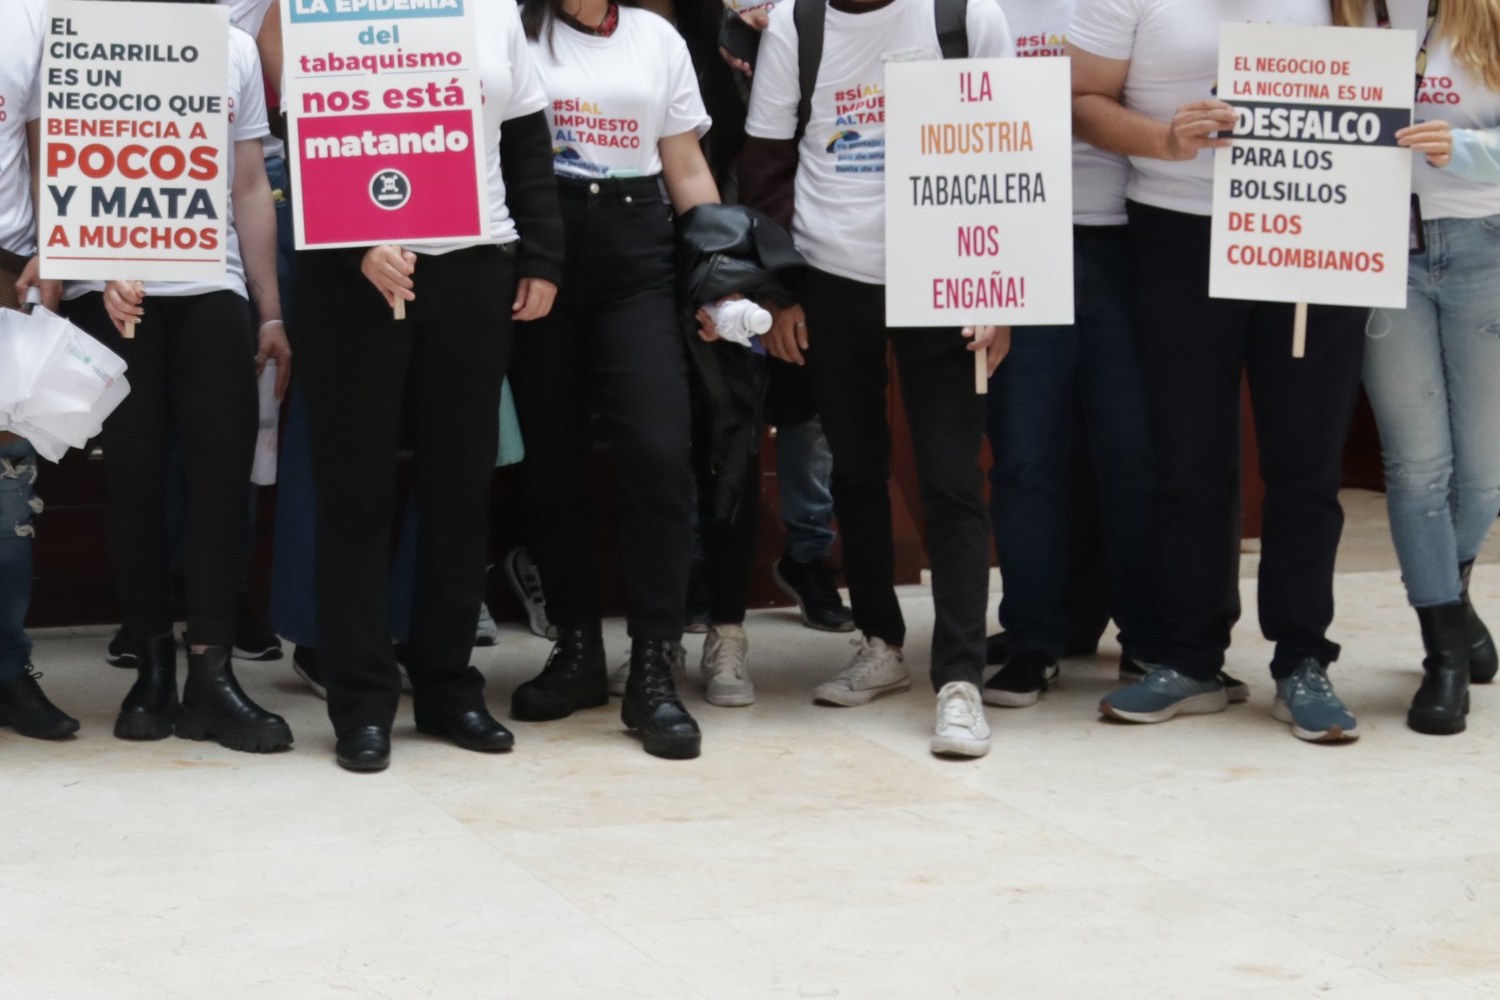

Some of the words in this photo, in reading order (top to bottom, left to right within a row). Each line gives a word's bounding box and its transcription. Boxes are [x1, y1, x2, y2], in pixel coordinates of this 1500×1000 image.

[51, 18, 78, 35] EL
[358, 25, 399, 45] del
[50, 42, 199, 63] CIGARRILLO
[300, 48, 462, 74] tabaquismo
[49, 68, 79, 86] ES
[87, 70, 122, 87] UN
[1234, 57, 1251, 71] EL
[1256, 58, 1326, 74] NEGOCIO
[1331, 61, 1350, 75] DE
[302, 88, 370, 113] nos
[383, 78, 464, 108] está
[1234, 81, 1252, 96] LA
[1257, 82, 1329, 99] NICOTINA
[1338, 86, 1356, 100] ES
[1361, 87, 1383, 101] UN
[48, 92, 162, 112] NEGOCIO
[169, 95, 221, 116] QUE
[48, 118, 181, 139] BENEFICIA
[189, 122, 207, 139] A
[554, 115, 638, 132] IMPUESTO
[1233, 107, 1380, 142] DESFALCO
[305, 125, 469, 159] matando
[921, 121, 1033, 155] INDUSTRIA
[47, 142, 219, 181] POCOS
[1231, 147, 1286, 167] PARA
[1293, 150, 1333, 170] LOS
[909, 173, 1046, 206] TABACALERA
[1230, 179, 1347, 204] BOLSILLOS
[48, 185, 77, 217] Y
[91, 186, 218, 220] MATA
[1228, 212, 1255, 232] DE
[1261, 214, 1302, 235] LOS
[47, 225, 70, 247] A
[79, 225, 218, 250] MUCHOS
[958, 226, 999, 257] NOS
[1227, 245, 1384, 273] COLOMBIANOS
[933, 271, 1025, 309] ENGAÑA!
